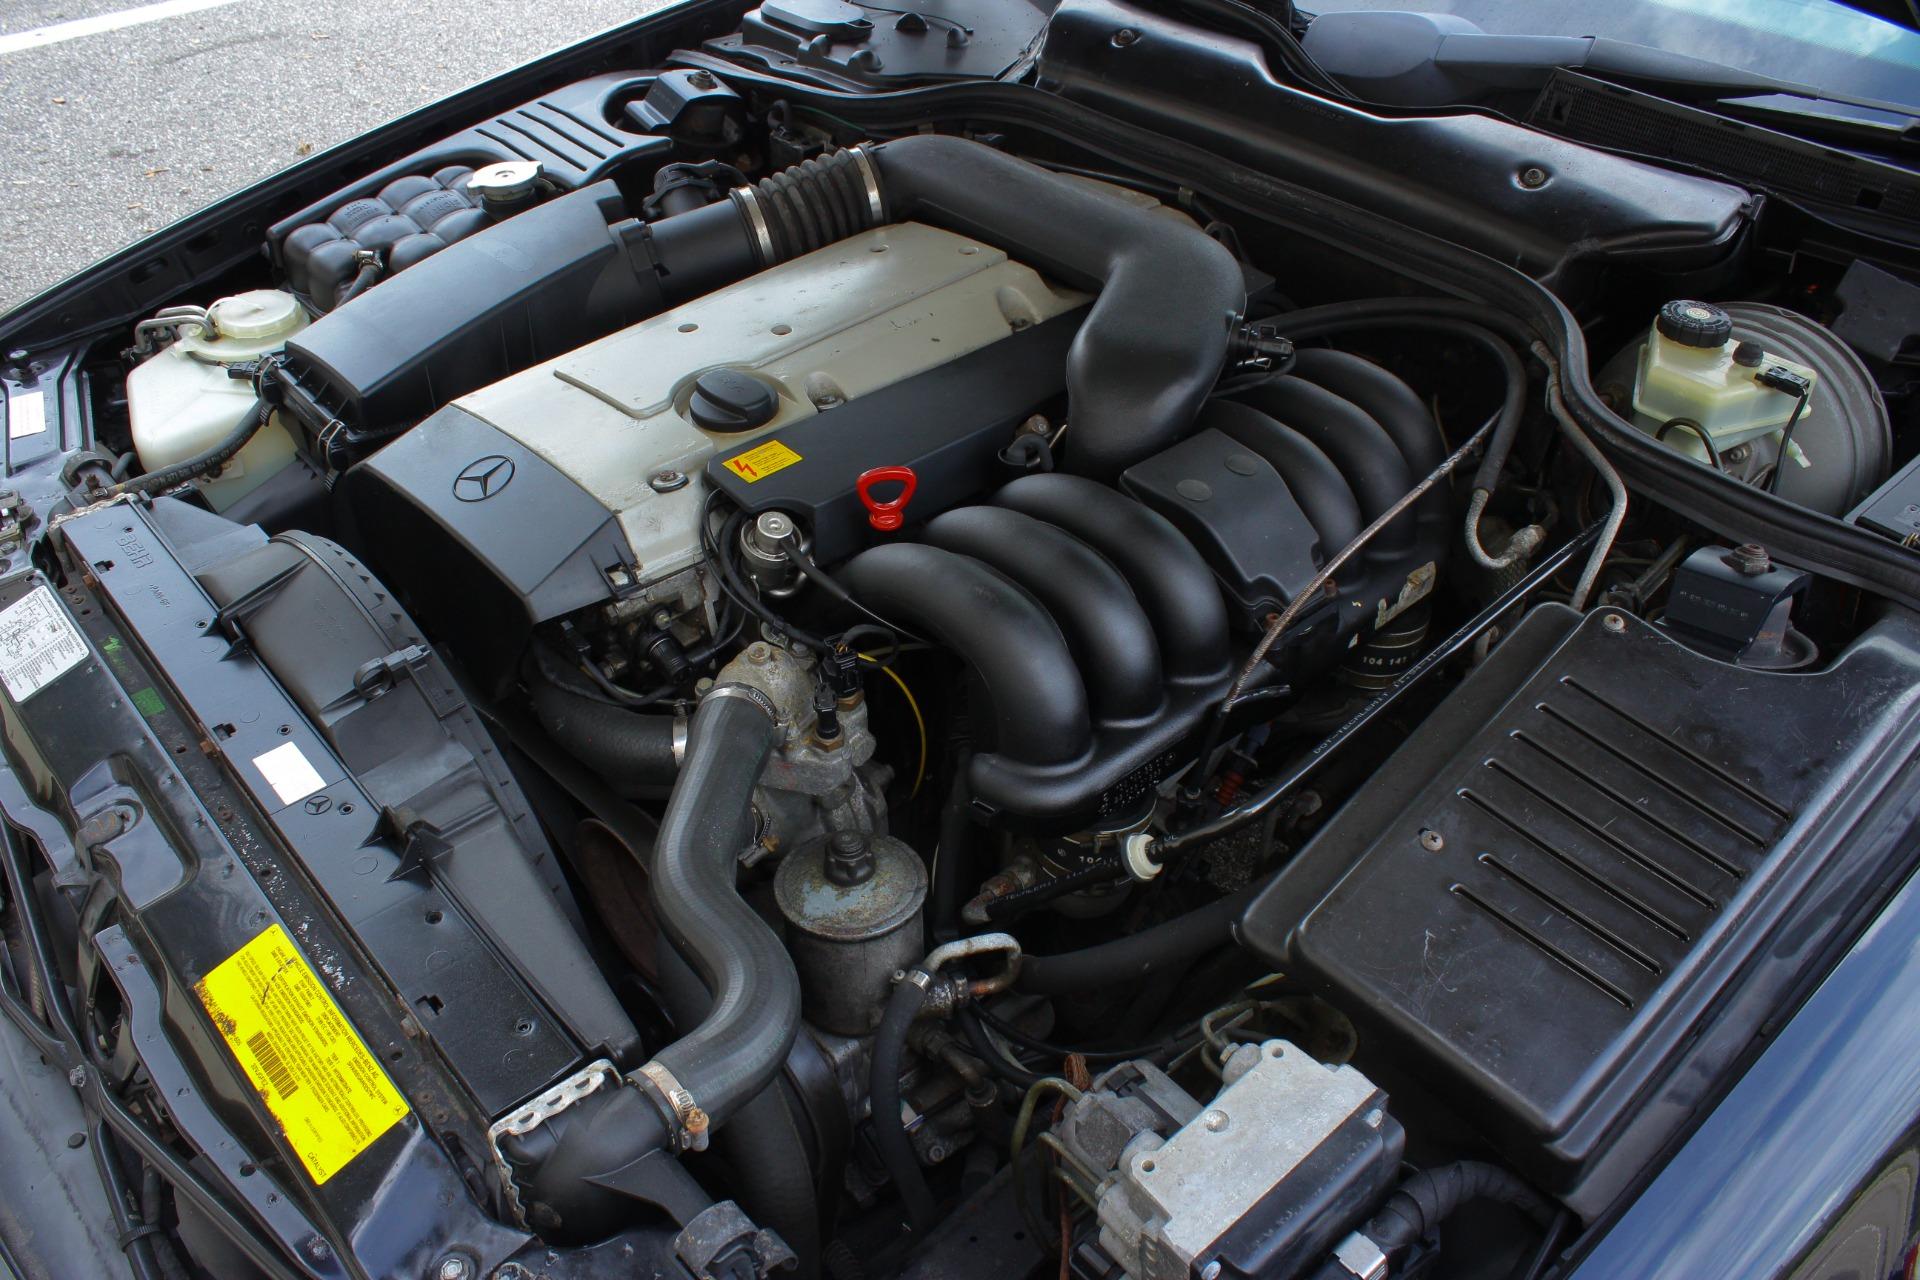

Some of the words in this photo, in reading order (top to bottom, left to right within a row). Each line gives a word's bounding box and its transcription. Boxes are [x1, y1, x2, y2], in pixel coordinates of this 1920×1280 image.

[115, 533, 153, 569] BEHR
[344, 1034, 372, 1069] MERCEDES-BENZ
[305, 1150, 327, 1180] CATALYST
